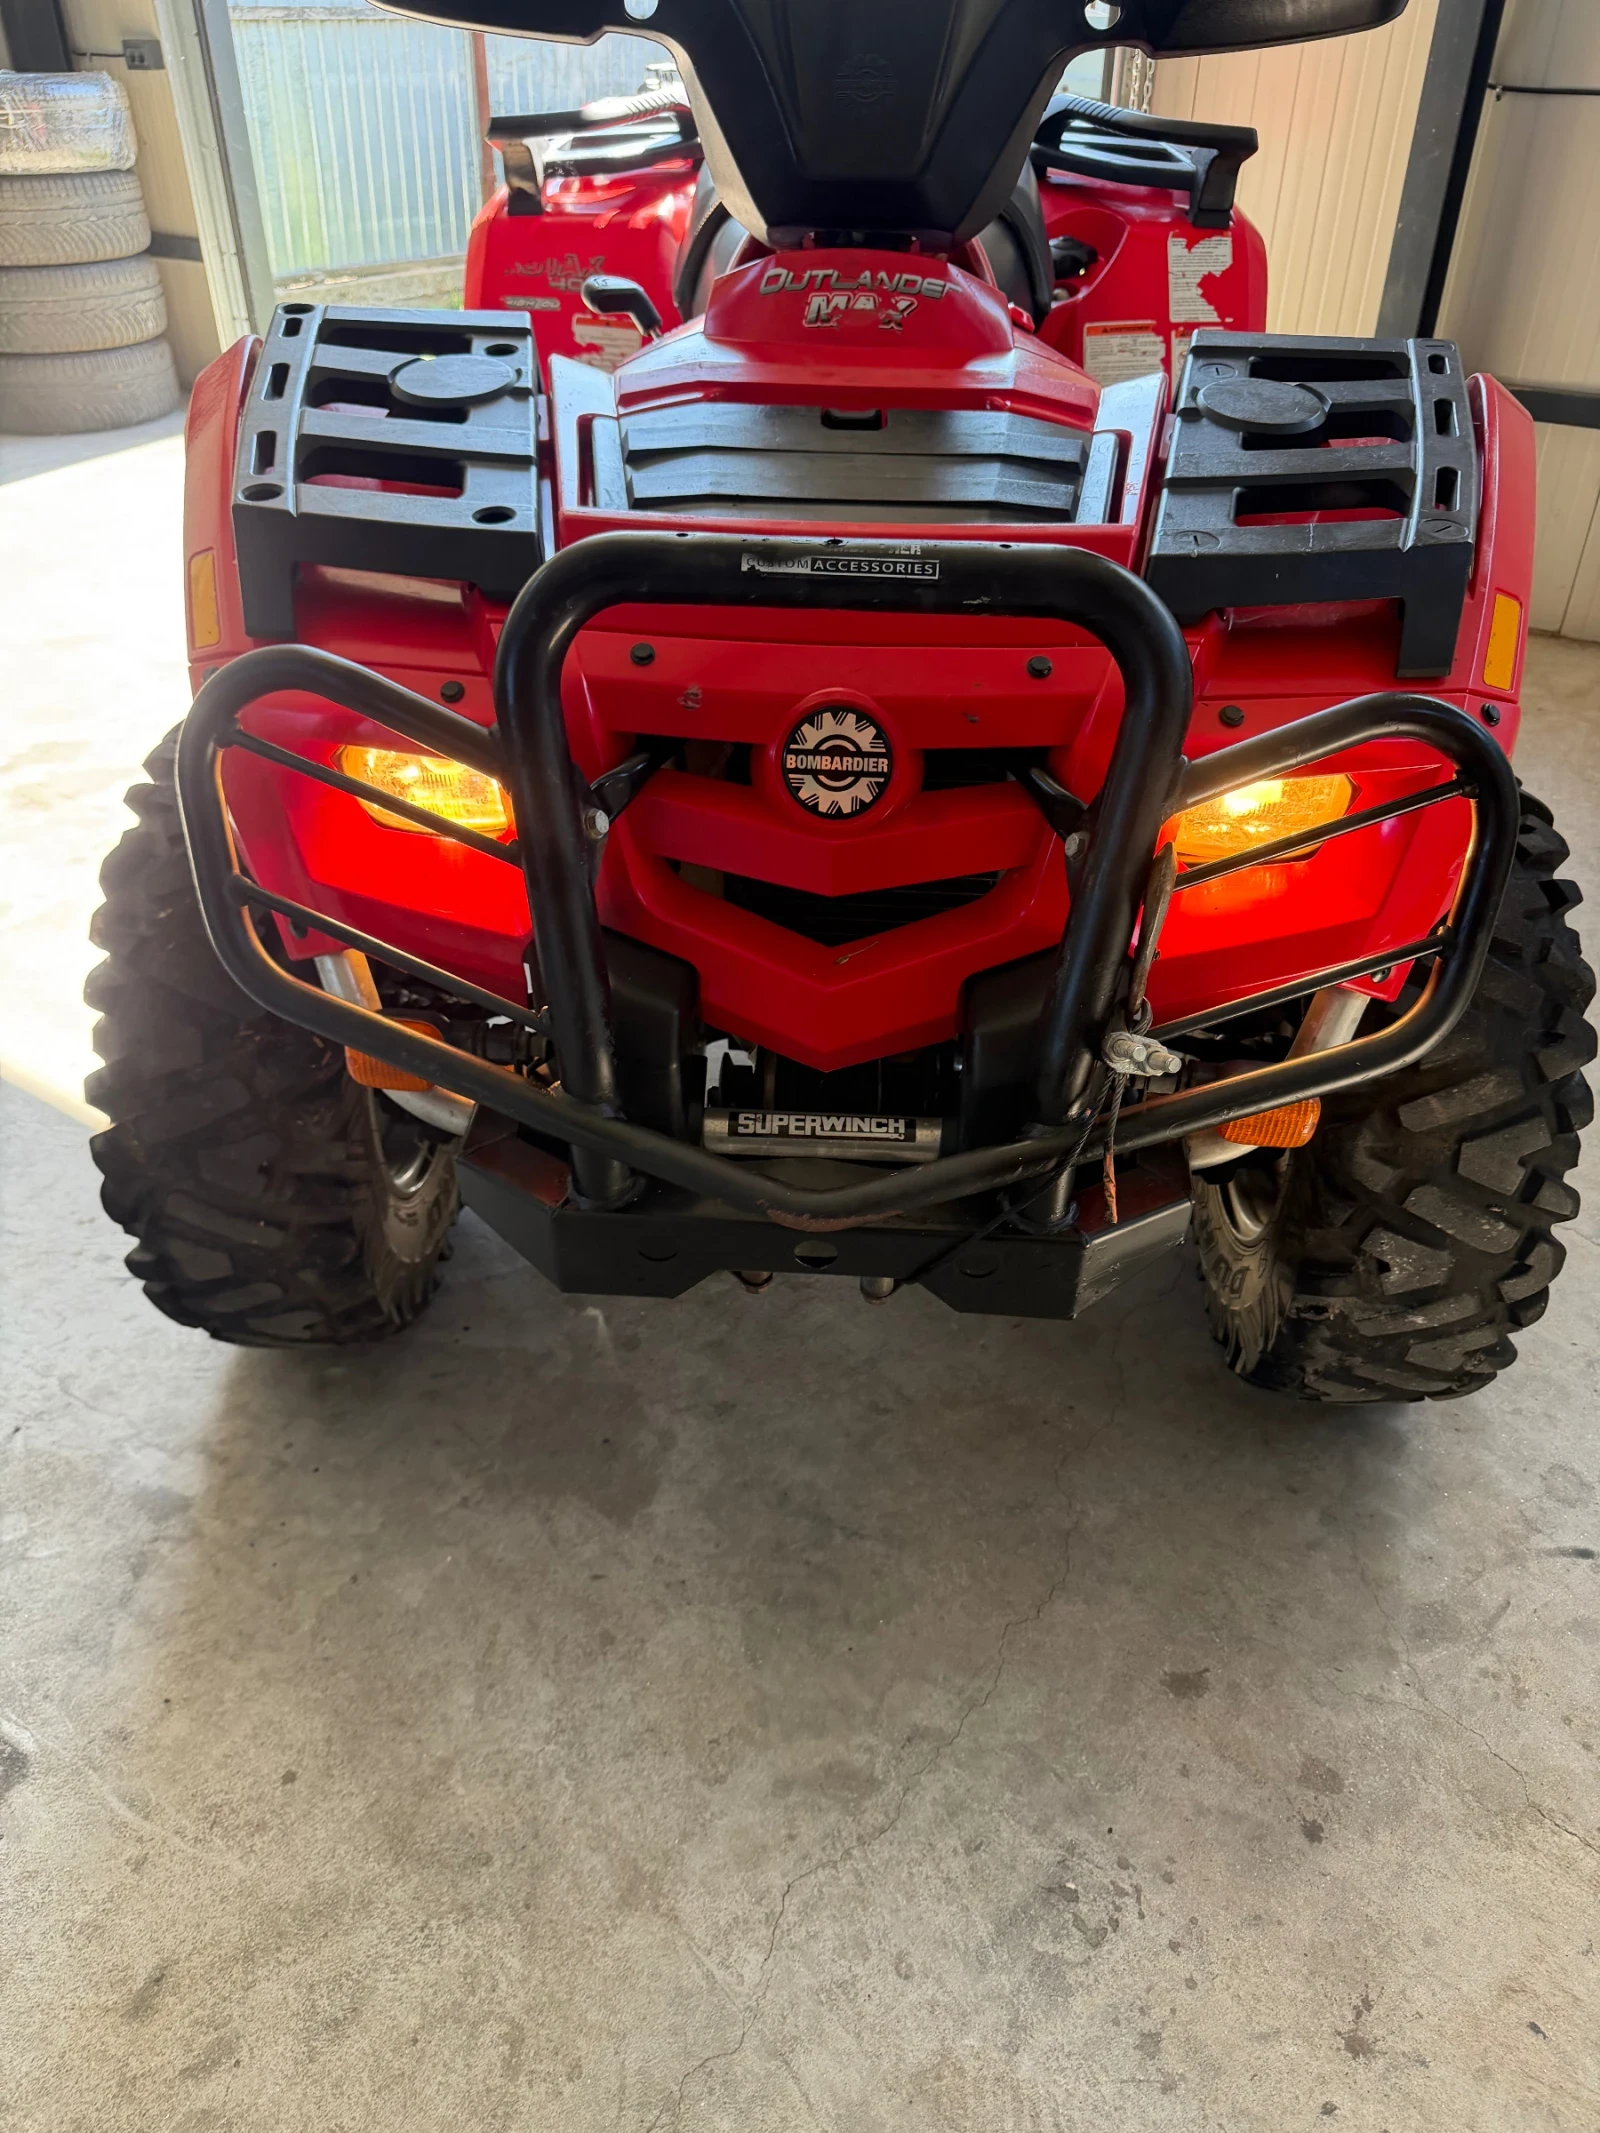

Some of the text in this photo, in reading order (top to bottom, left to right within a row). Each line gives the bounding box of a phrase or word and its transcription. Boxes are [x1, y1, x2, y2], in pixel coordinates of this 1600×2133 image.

[813, 560, 933, 575] ACCESSORIES
[786, 754, 889, 773] BOMBARDIER
[737, 1112, 906, 1138] SUPERWINCH
